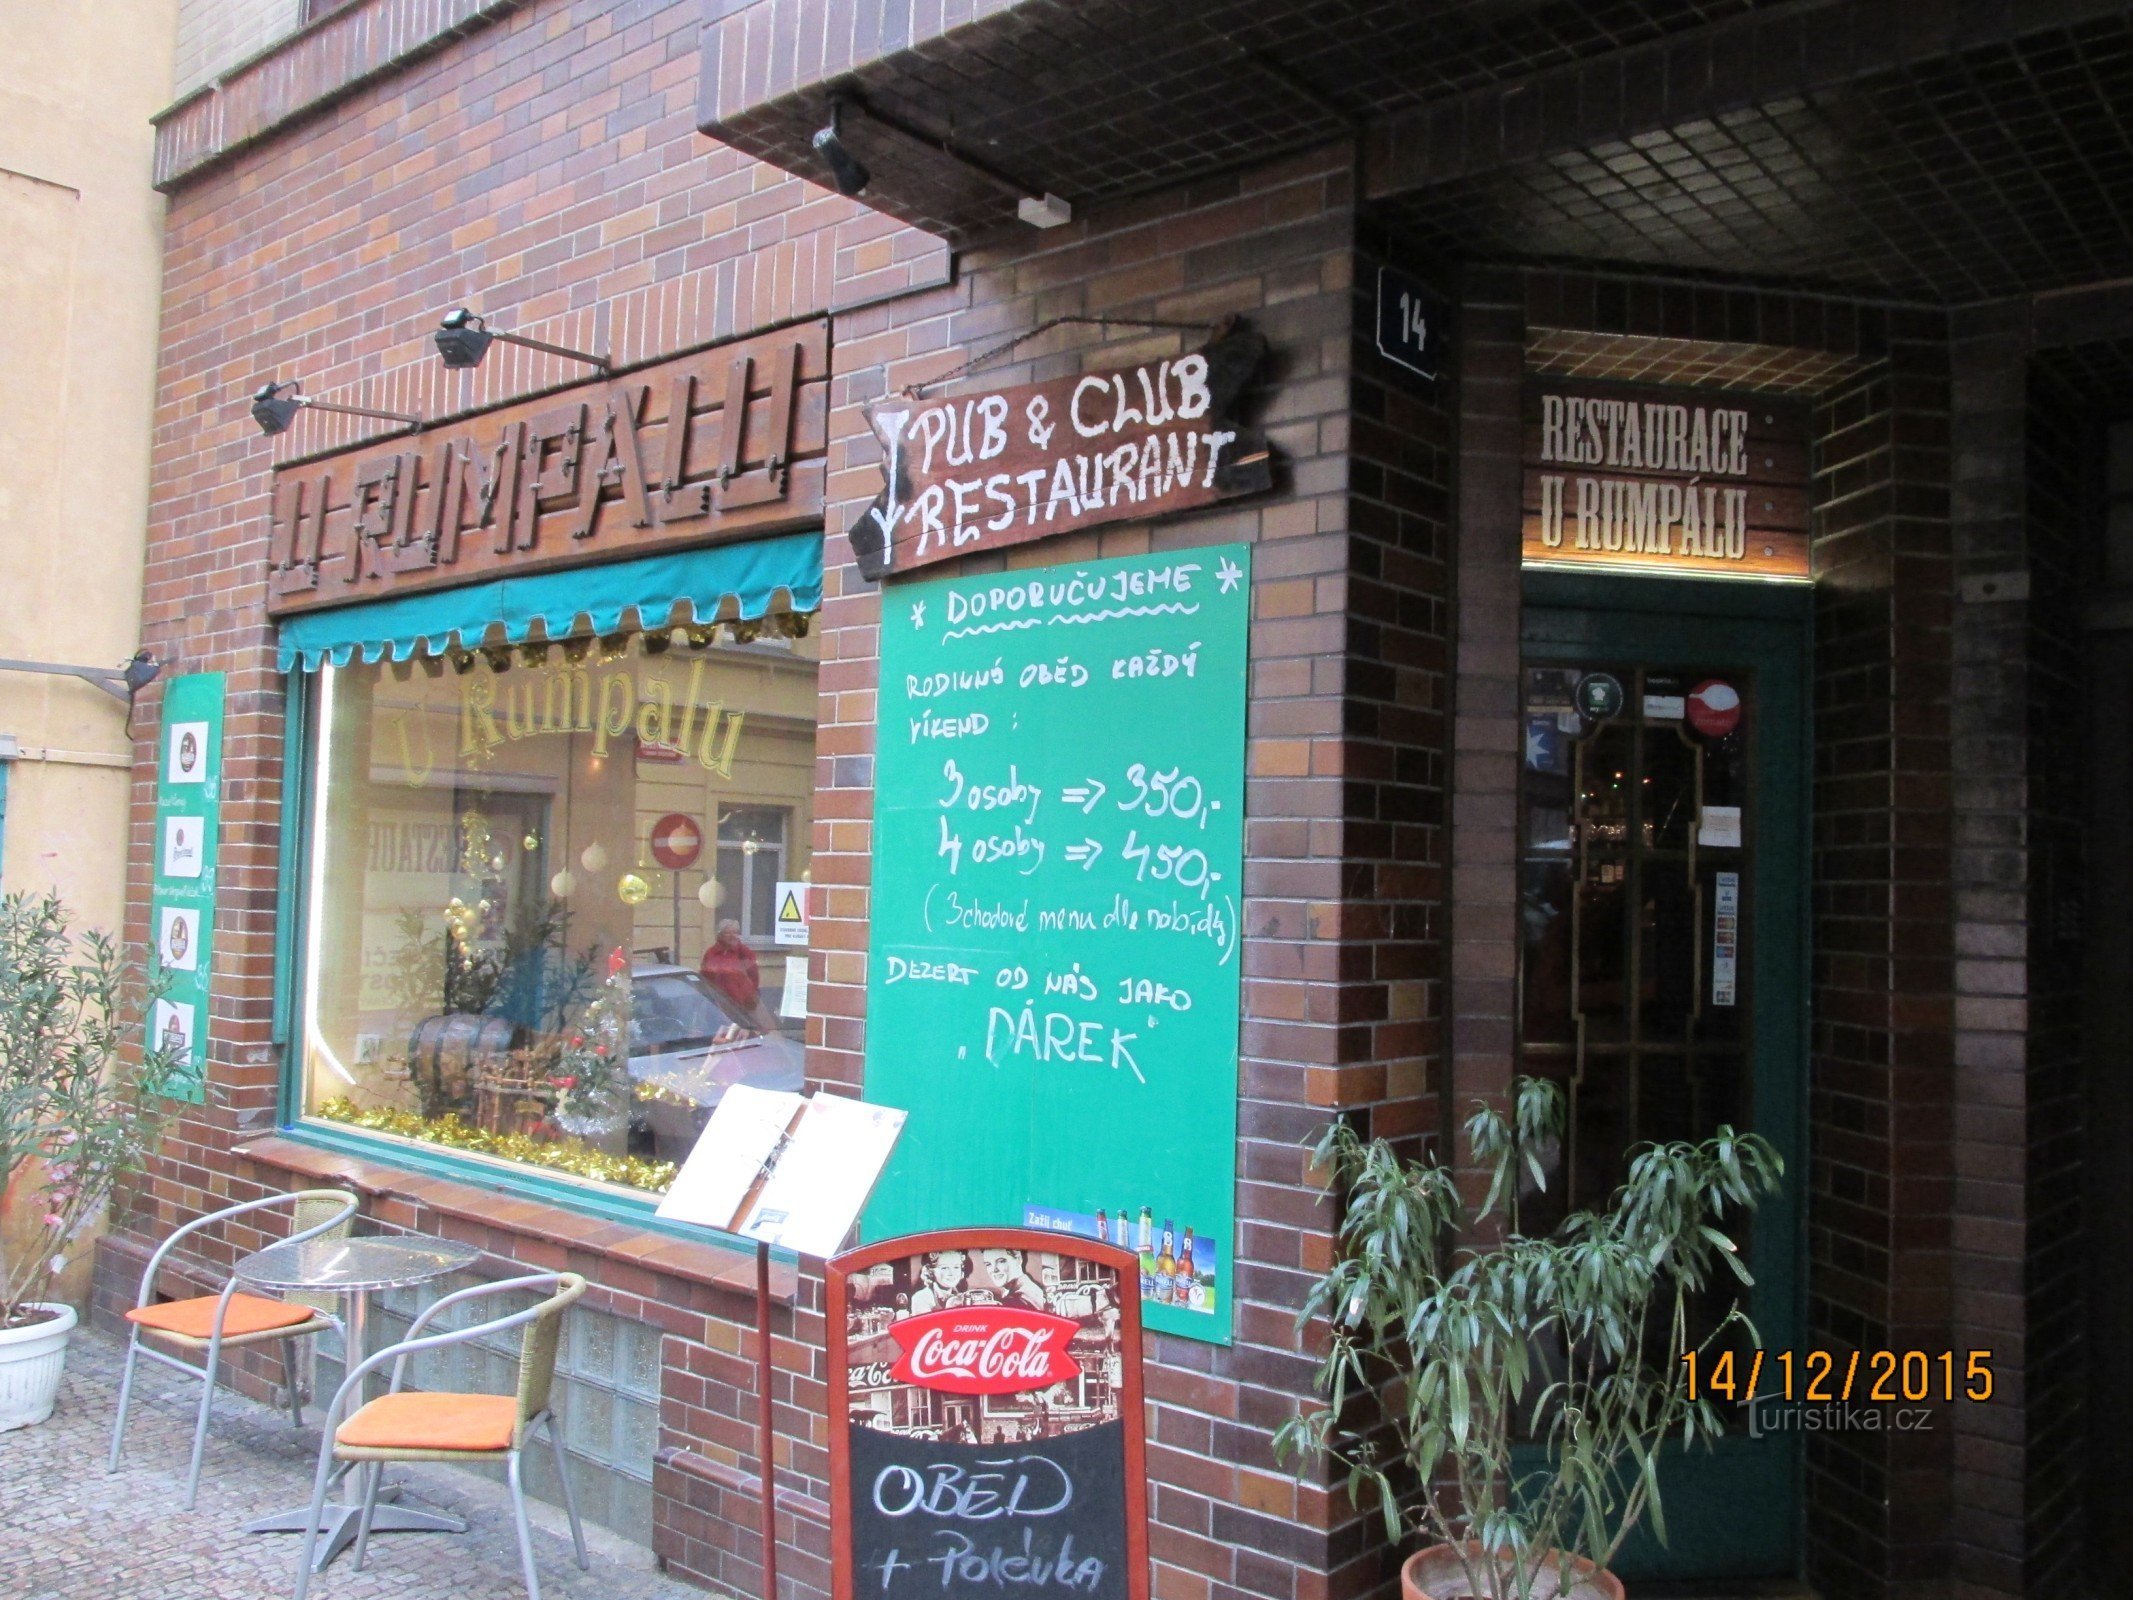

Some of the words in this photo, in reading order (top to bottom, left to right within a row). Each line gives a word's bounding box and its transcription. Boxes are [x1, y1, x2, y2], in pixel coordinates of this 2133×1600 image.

[1400, 291, 1426, 351] 14
[908, 396, 1009, 474] PUB
[1025, 395, 1056, 450] &
[1070, 354, 1211, 438] CLUB
[1540, 394, 1748, 476] RESTAURACE
[905, 431, 1236, 556] RESTAURANT
[1540, 475, 1566, 547] U
[1575, 476, 1748, 560] RUMPÁLU
[273, 474, 329, 595] U
[948, 564, 1202, 624] DOPORUČUJEME
[1020, 656, 1088, 688] OBĚD
[1112, 642, 1202, 679] KAŽDÝ
[460, 655, 746, 780] Rumpálu
[939, 760, 963, 807] 3
[968, 765, 1041, 824] osoby
[938, 815, 962, 874] 4
[972, 825, 1045, 875] osoby
[1040, 907, 1097, 932] menu
[1104, 894, 1137, 930] dle
[886, 956, 979, 985] DEZERT
[997, 966, 1028, 989] OD
[1045, 963, 1097, 1000] NÁS
[1118, 979, 1192, 1011] JAKO
[910, 1327, 1055, 1379] Coca-Cola
[953, 1324, 989, 1333] DRINK
